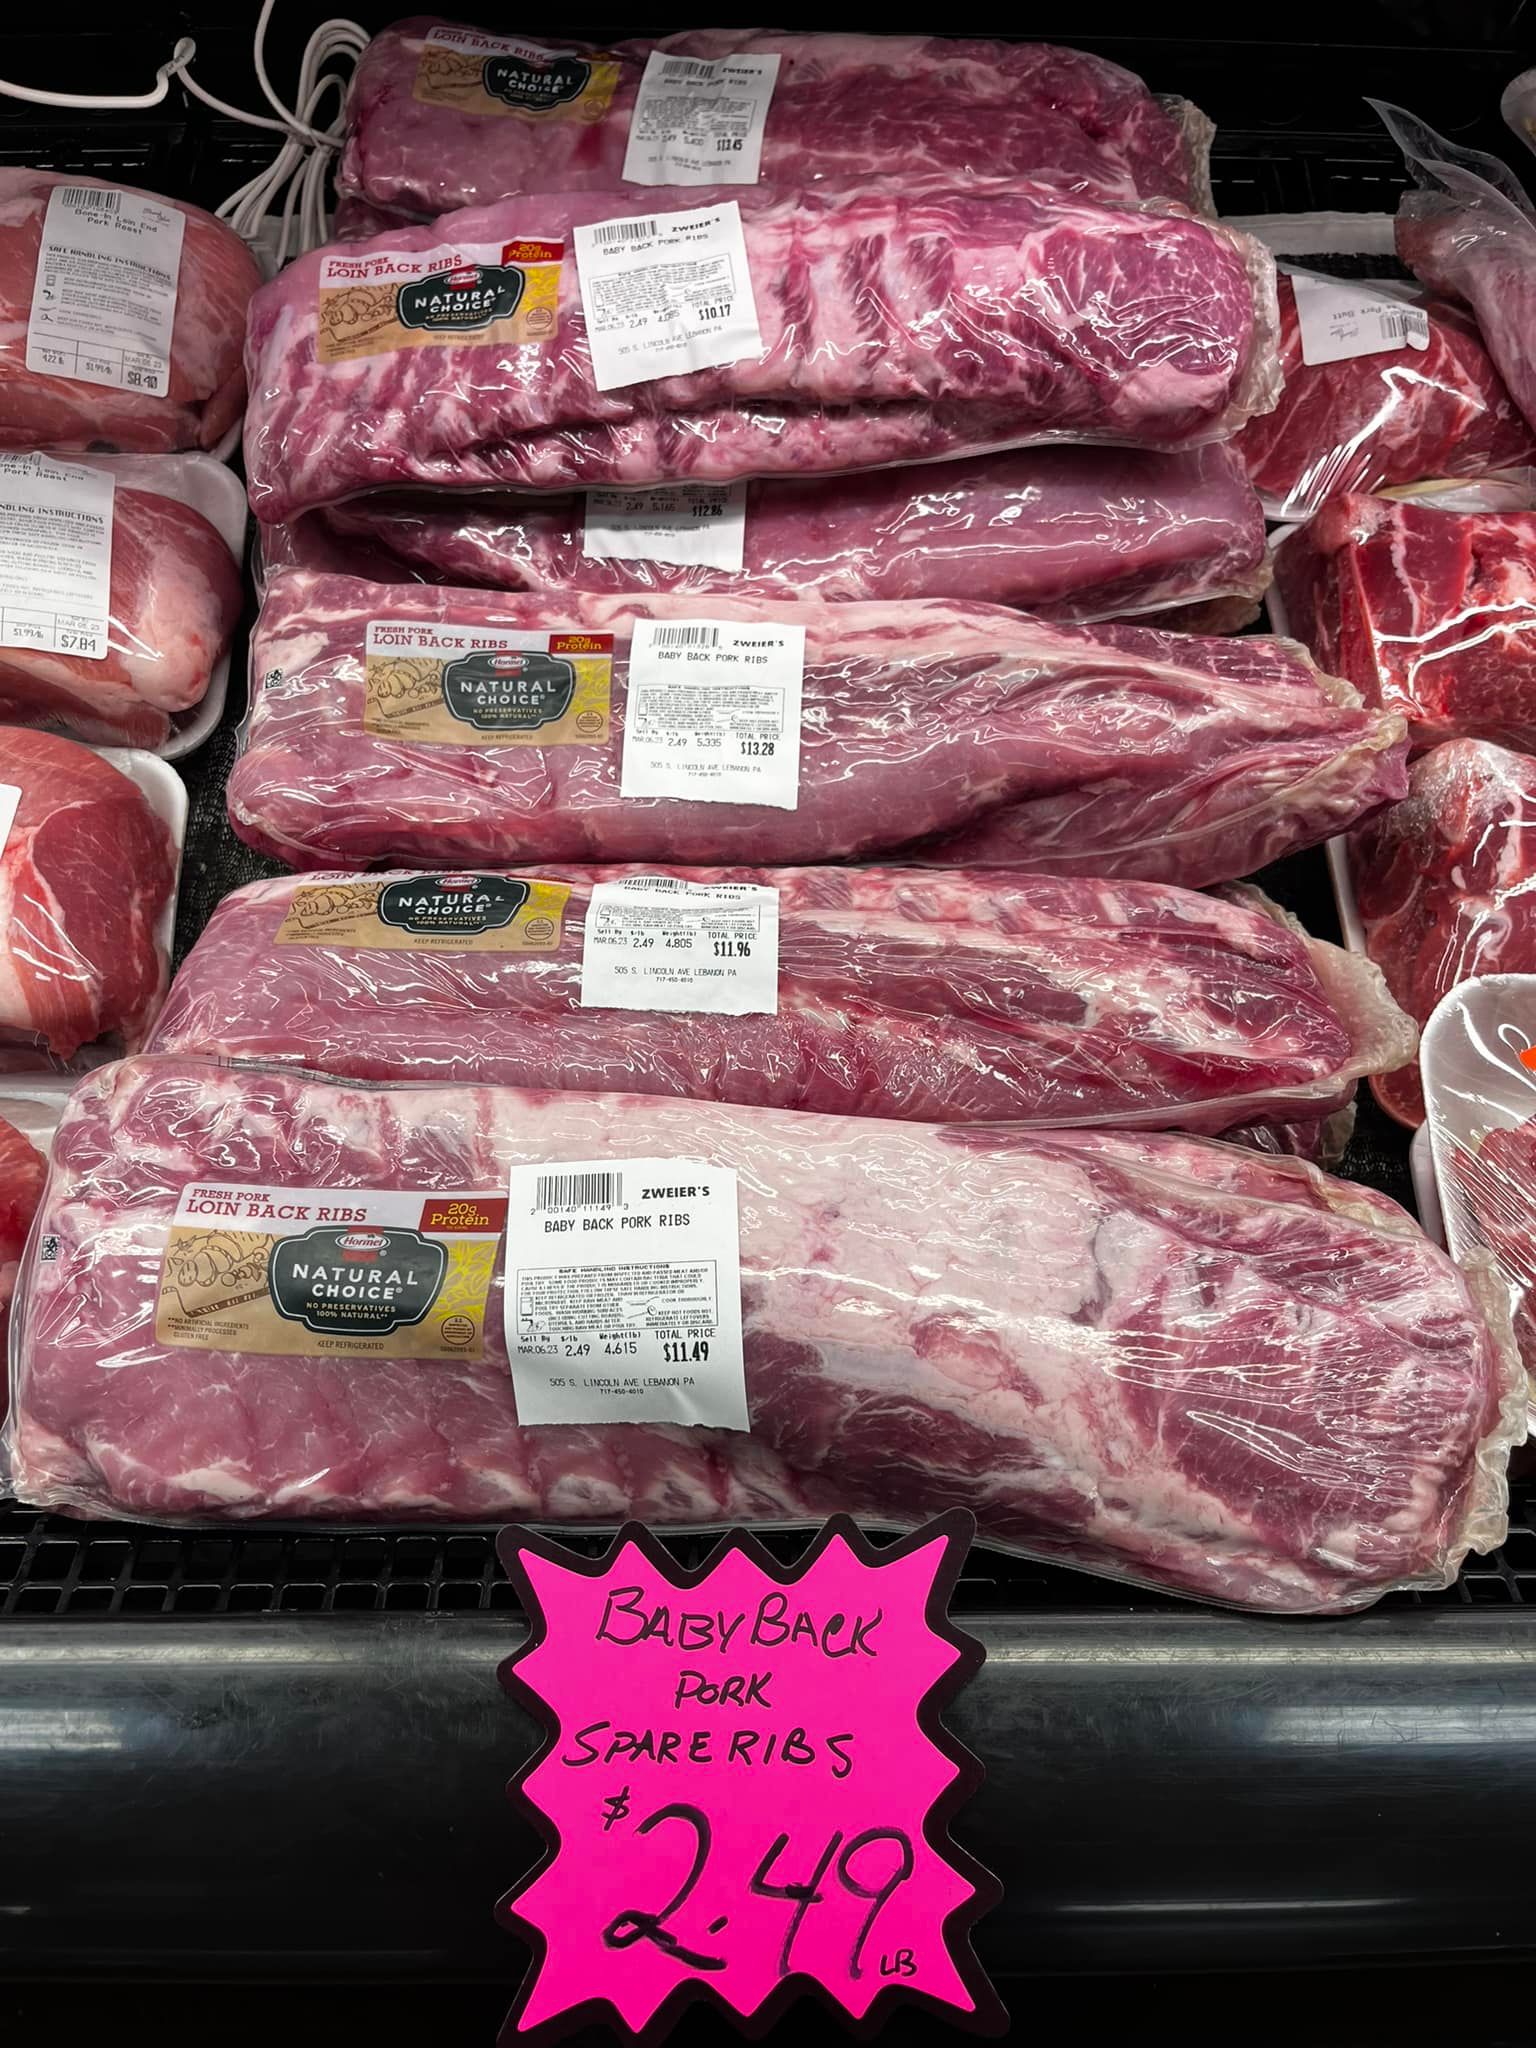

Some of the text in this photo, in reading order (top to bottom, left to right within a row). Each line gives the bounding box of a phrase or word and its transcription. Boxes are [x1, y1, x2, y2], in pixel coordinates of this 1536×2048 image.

[434, 32, 467, 44] LOIN
[471, 39, 509, 52] BACK
[497, 69, 573, 85] NATURAL
[671, 217, 721, 233] ZWEIER'S
[603, 246, 626, 256] BABY
[631, 242, 653, 252] BACK
[328, 254, 463, 278] LOIN BACK RIBS
[329, 256, 389, 268] FRESH PORK
[415, 285, 505, 308] NATURAL
[430, 300, 491, 313] CHOICE
[699, 304, 731, 321] $10.17
[38, 507, 104, 524] INSTRUCTIONS
[375, 626, 433, 635] FRESH PORK
[61, 634, 96, 652] $7.84
[373, 633, 508, 649] LOIN BACK RIBS
[556, 641, 602, 651] Protein
[733, 639, 785, 648] ZWEIER'S
[658, 651, 769, 664] BABY BACK PORK RIBS
[460, 681, 557, 693] NATURAL
[477, 695, 540, 705] CHOICE
[668, 737, 722, 747] 2.49 5.335
[736, 732, 756, 740] TOTAL
[741, 741, 775, 756] $13.28
[311, 873, 355, 881] LOIN
[398, 893, 505, 907] NATURAL
[415, 905, 485, 915] CHOICE
[708, 931, 757, 940] TOTAL PRICE
[633, 938, 655, 948] 2.49
[665, 938, 693, 948] 4.805
[714, 941, 751, 957] $11.96
[614, 966, 629, 974] 505
[644, 967, 675, 976] LINCOLN
[677, 967, 691, 976] AVE
[694, 968, 725, 977] LEBANON
[727, 968, 737, 977] PA
[191, 1188, 270, 1203] FRESH PORK
[642, 1186, 711, 1200] ZWEIER'S
[186, 1199, 368, 1223] LOIN BACK RIBS
[448, 1203, 477, 1217] 20g
[530, 1203, 629, 1216] 2 00140 11149 3
[430, 1213, 490, 1226] Protein
[544, 1213, 691, 1233] BABY BACK PORK RIBS
[343, 1236, 384, 1247] Hormel
[292, 1263, 418, 1285] NATURAL
[311, 1284, 395, 1300] CHOICE
[316, 1310, 338, 1318] 100%
[322, 1302, 396, 1312] PRESERVATIVES
[541, 1335, 551, 1343] By
[599, 1331, 641, 1341] Weight(lb)
[655, 1328, 715, 1340] TOTAL PRICE
[318, 1341, 384, 1351] KEEP REFRIGERATED
[564, 1344, 591, 1357] 2.49
[604, 1341, 638, 1355] 4.615
[663, 1341, 710, 1362] $11.49
[550, 1378, 566, 1387] 505
[583, 1378, 620, 1387] LINCOLN
[624, 1378, 640, 1387] AVE
[643, 1377, 680, 1387] LEBANON
[683, 1376, 695, 1386] PA
[596, 1586, 882, 1657] BABY BACK
[674, 1671, 772, 1708] PORK
[562, 1721, 854, 1778] SPARE RIBS
[880, 1949, 918, 1977] LB
